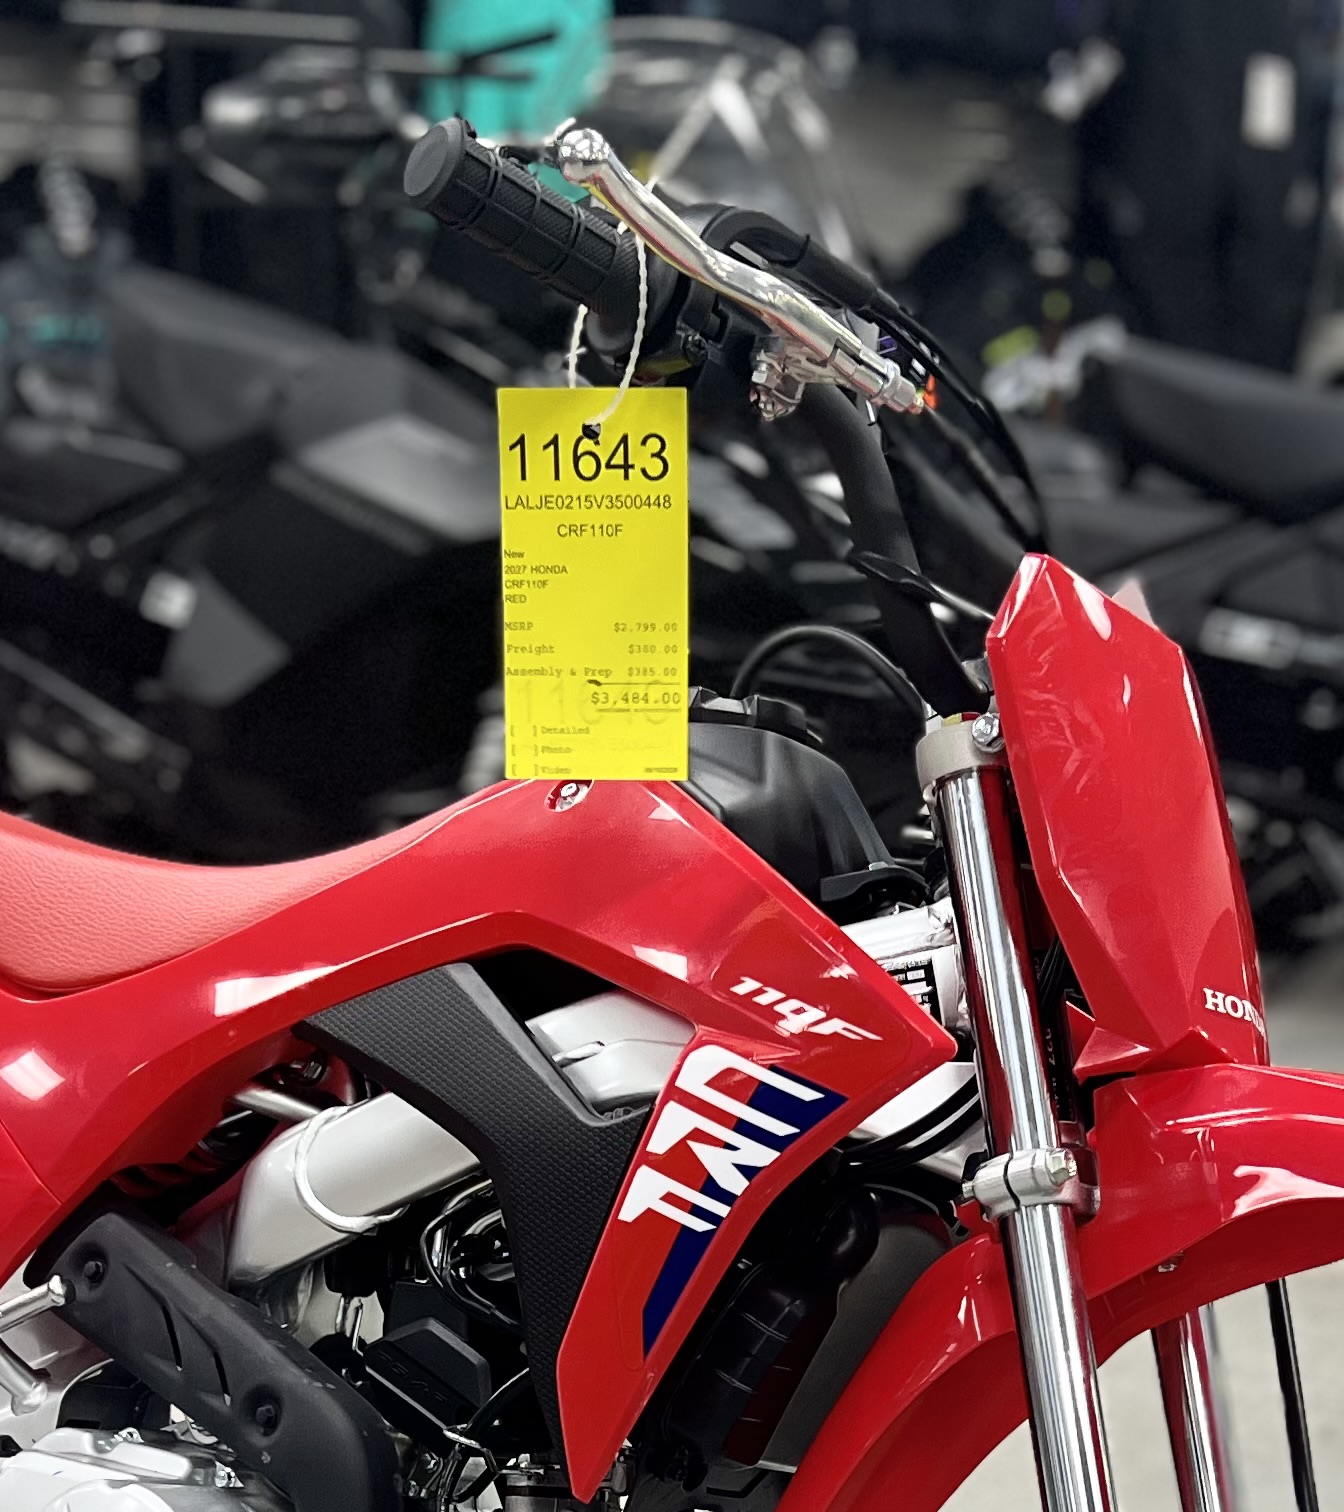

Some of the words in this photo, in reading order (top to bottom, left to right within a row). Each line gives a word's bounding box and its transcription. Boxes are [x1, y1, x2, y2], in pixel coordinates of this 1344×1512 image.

[509, 433, 670, 482] 11643
[505, 494, 672, 510] LALJE0215V3500448
[557, 524, 624, 538] CRF110F
[504, 549, 525, 559] New
[530, 564, 569, 575] HONDA
[505, 594, 527, 604] RED
[506, 643, 556, 656] Freight
[506, 667, 563, 679] Assembly
[591, 691, 682, 706] $3,484.00
[617, 1044, 826, 1233] CRF
